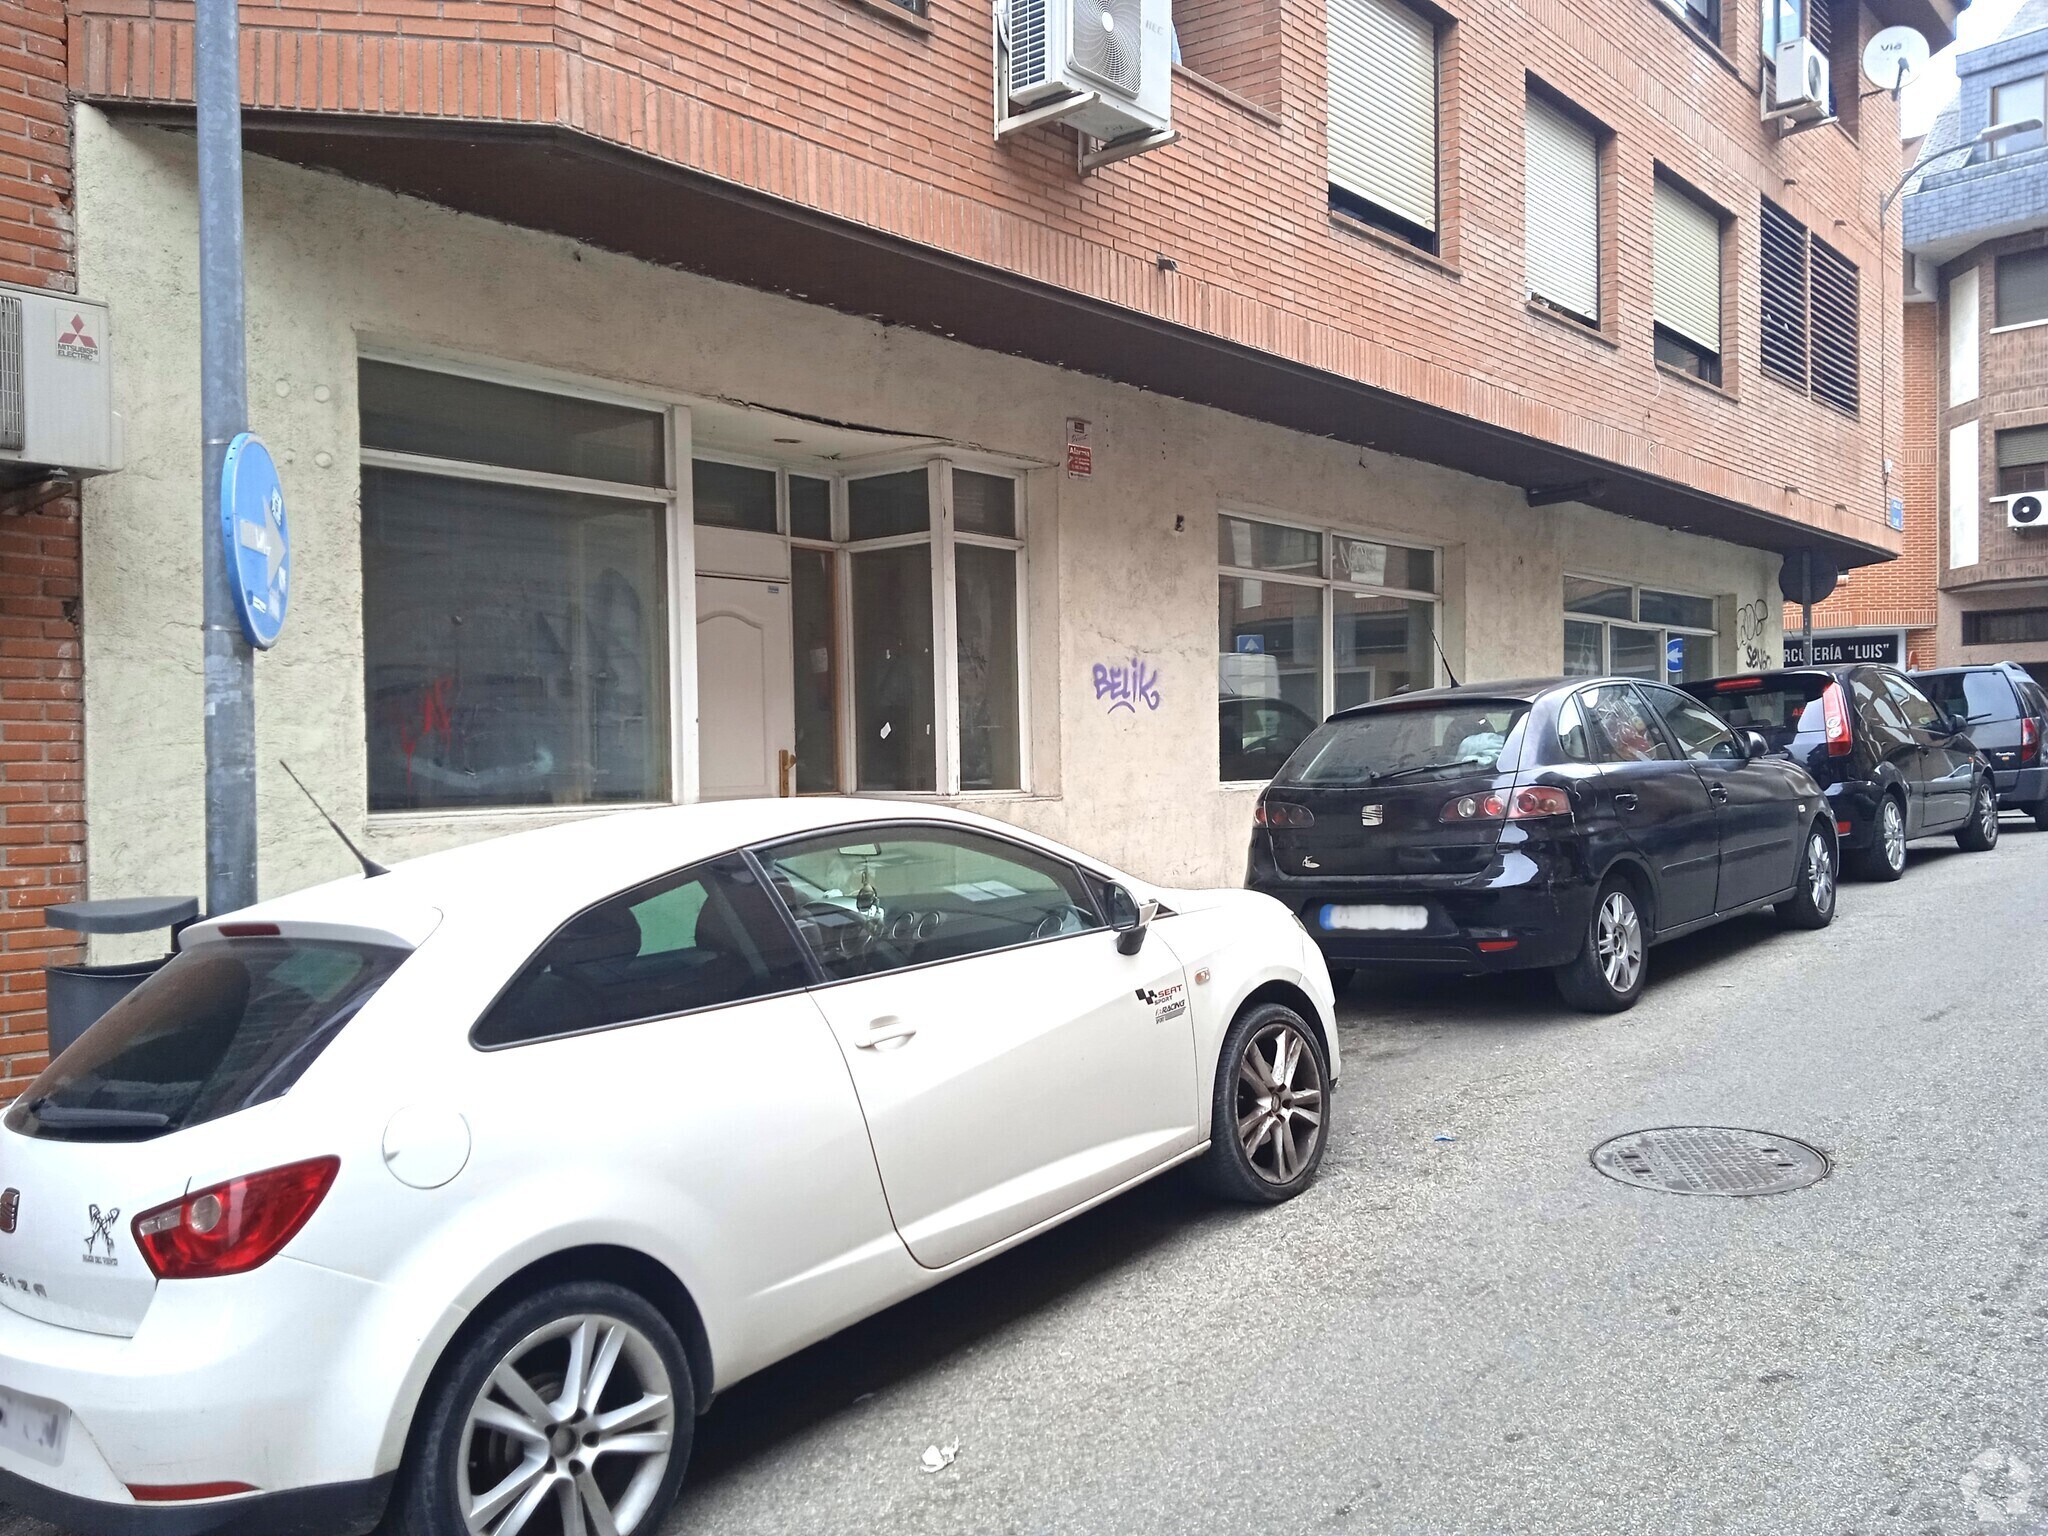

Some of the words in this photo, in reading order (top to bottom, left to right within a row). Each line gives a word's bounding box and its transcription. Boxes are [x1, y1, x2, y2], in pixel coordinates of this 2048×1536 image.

[57, 343, 98, 356] MITSUBISHI
[57, 349, 93, 361] ELECTRIC
[1784, 643, 1842, 662] RCUERÍA
[1157, 984, 1183, 998] SEAT
[1154, 994, 1173, 1006] SPORT
